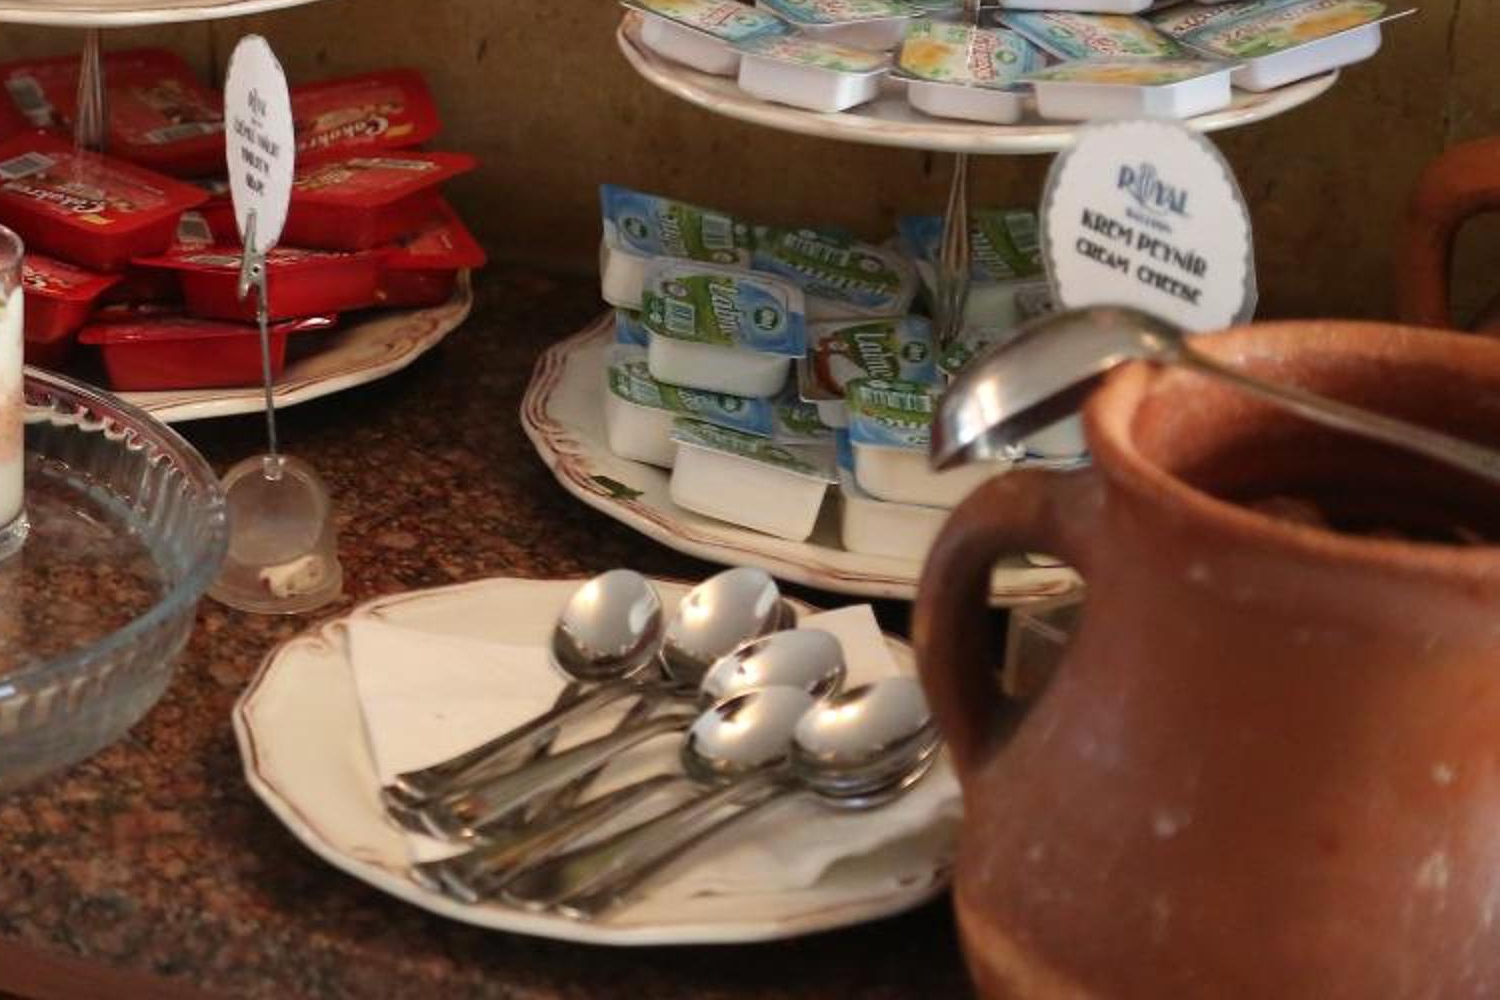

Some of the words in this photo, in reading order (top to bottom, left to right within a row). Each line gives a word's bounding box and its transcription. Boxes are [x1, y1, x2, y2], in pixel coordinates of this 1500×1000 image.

[1116, 161, 1193, 218] ROYAL
[1075, 237, 1130, 274] CREAM
[1136, 265, 1203, 306] CHEESE
[1081, 207, 1134, 246] KREM
[1137, 233, 1208, 279] PEYNİR
